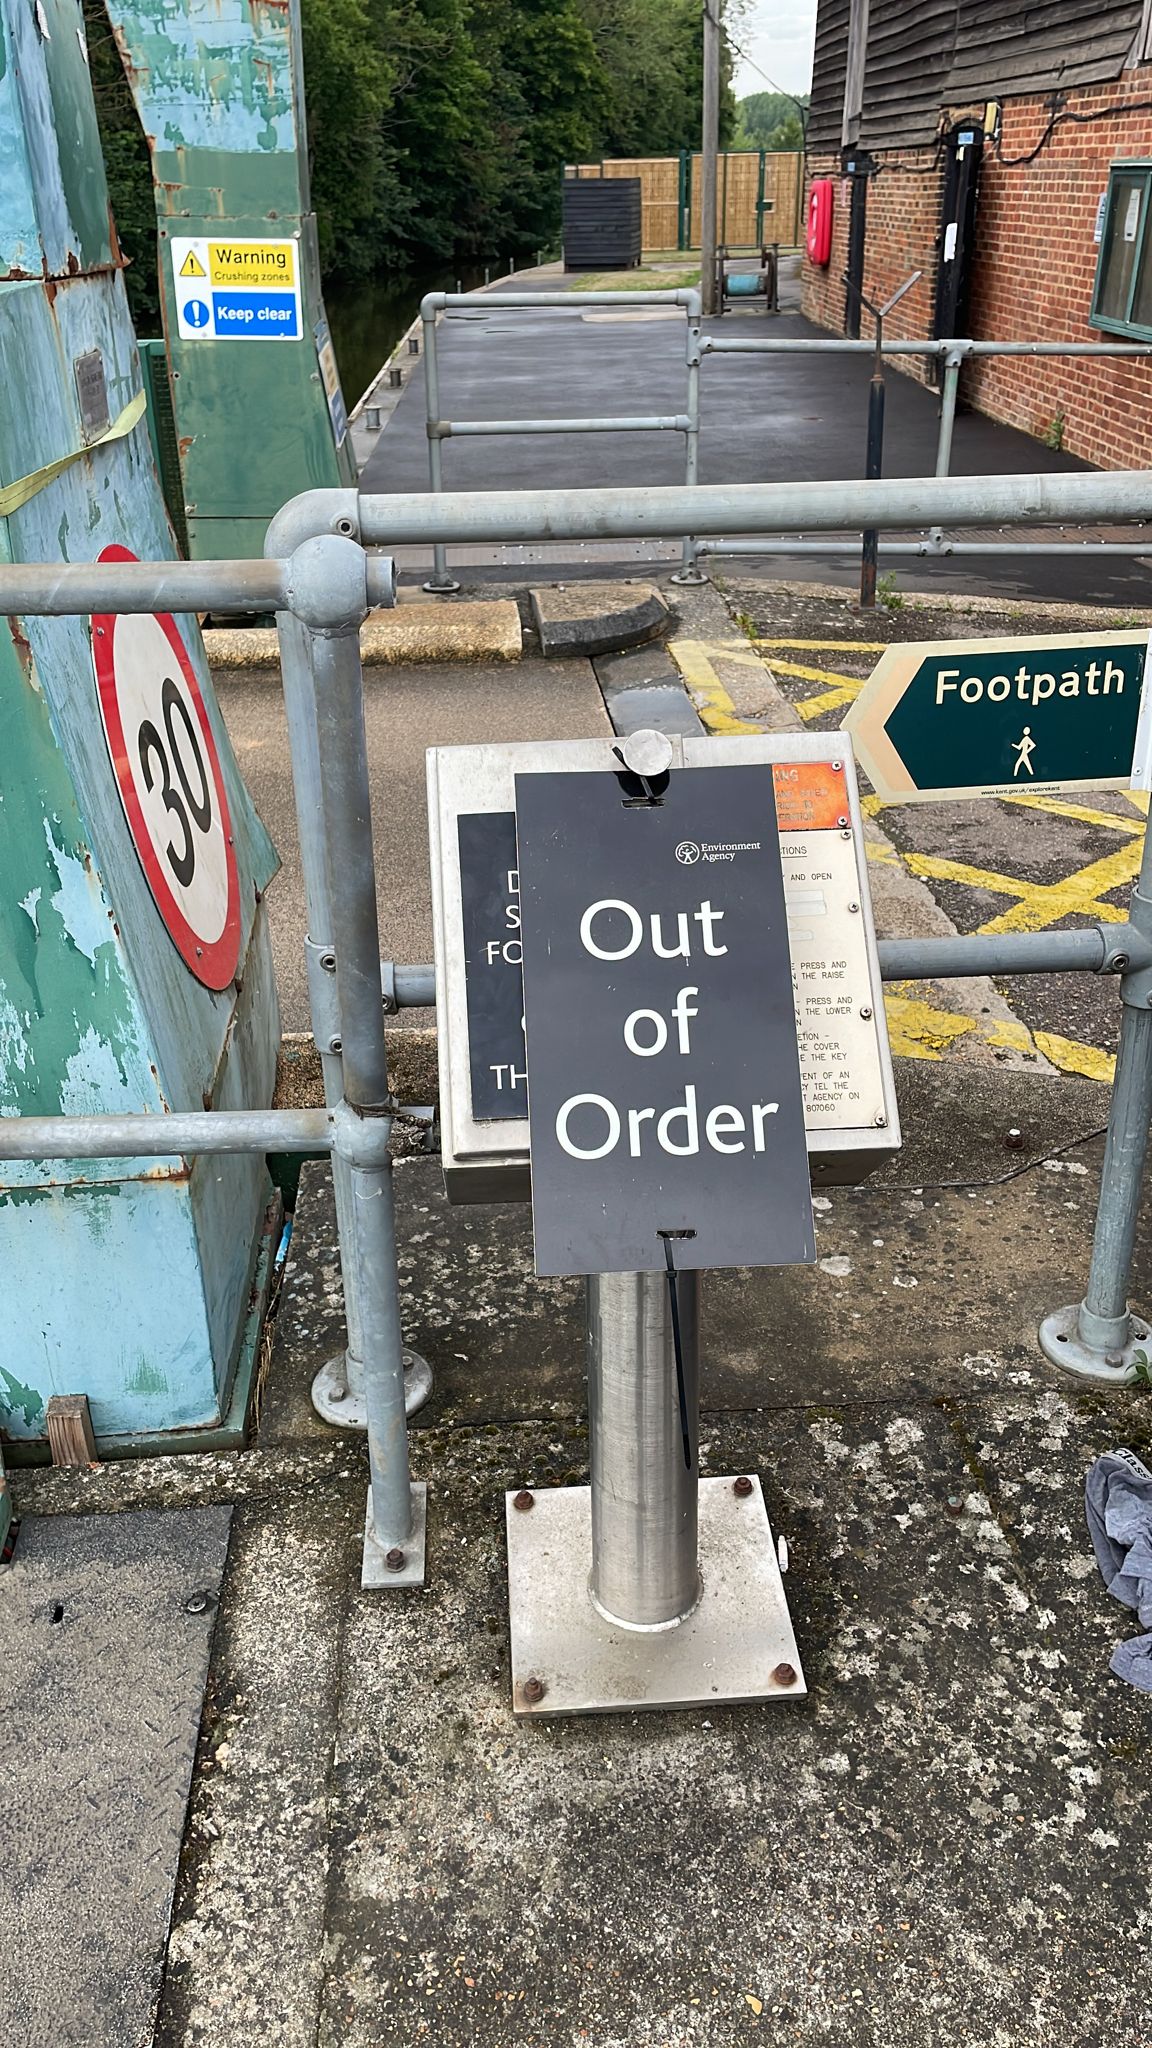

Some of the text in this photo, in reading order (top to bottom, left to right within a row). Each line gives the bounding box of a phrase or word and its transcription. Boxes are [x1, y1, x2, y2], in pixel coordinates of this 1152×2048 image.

[216, 249, 286, 268] Warning
[214, 271, 290, 283] Crushing zones
[217, 306, 292, 323] Keep clear
[935, 660, 1125, 706] Footpath
[138, 677, 212, 888] 30
[701, 842, 761, 852] Environment
[780, 846, 808, 855] TIONS
[701, 852, 736, 863] Agency
[811, 873, 832, 881] OPEN
[579, 899, 729, 961] Out
[800, 961, 826, 970] PRESS
[831, 961, 847, 969] AND
[801, 972, 817, 980] THE
[822, 971, 845, 979] RAISE
[806, 997, 832, 1005] PRESS
[837, 996, 853, 1004] AND
[805, 1008, 821, 1016] THE
[825, 1007, 852, 1015] LOWER
[623, 986, 699, 1057] of
[813, 1042, 840, 1051] COVER
[811, 1053, 826, 1061] THE
[831, 1052, 847, 1060] KEY
[801, 1071, 850, 1080] ENT OF AN
[814, 1082, 828, 1090] TEL
[833, 1081, 849, 1090] THE
[812, 1092, 843, 1101] AGENCY
[849, 1091, 860, 1100] ON
[806, 1103, 836, 1112] 807060
[555, 1084, 780, 1160] Order
